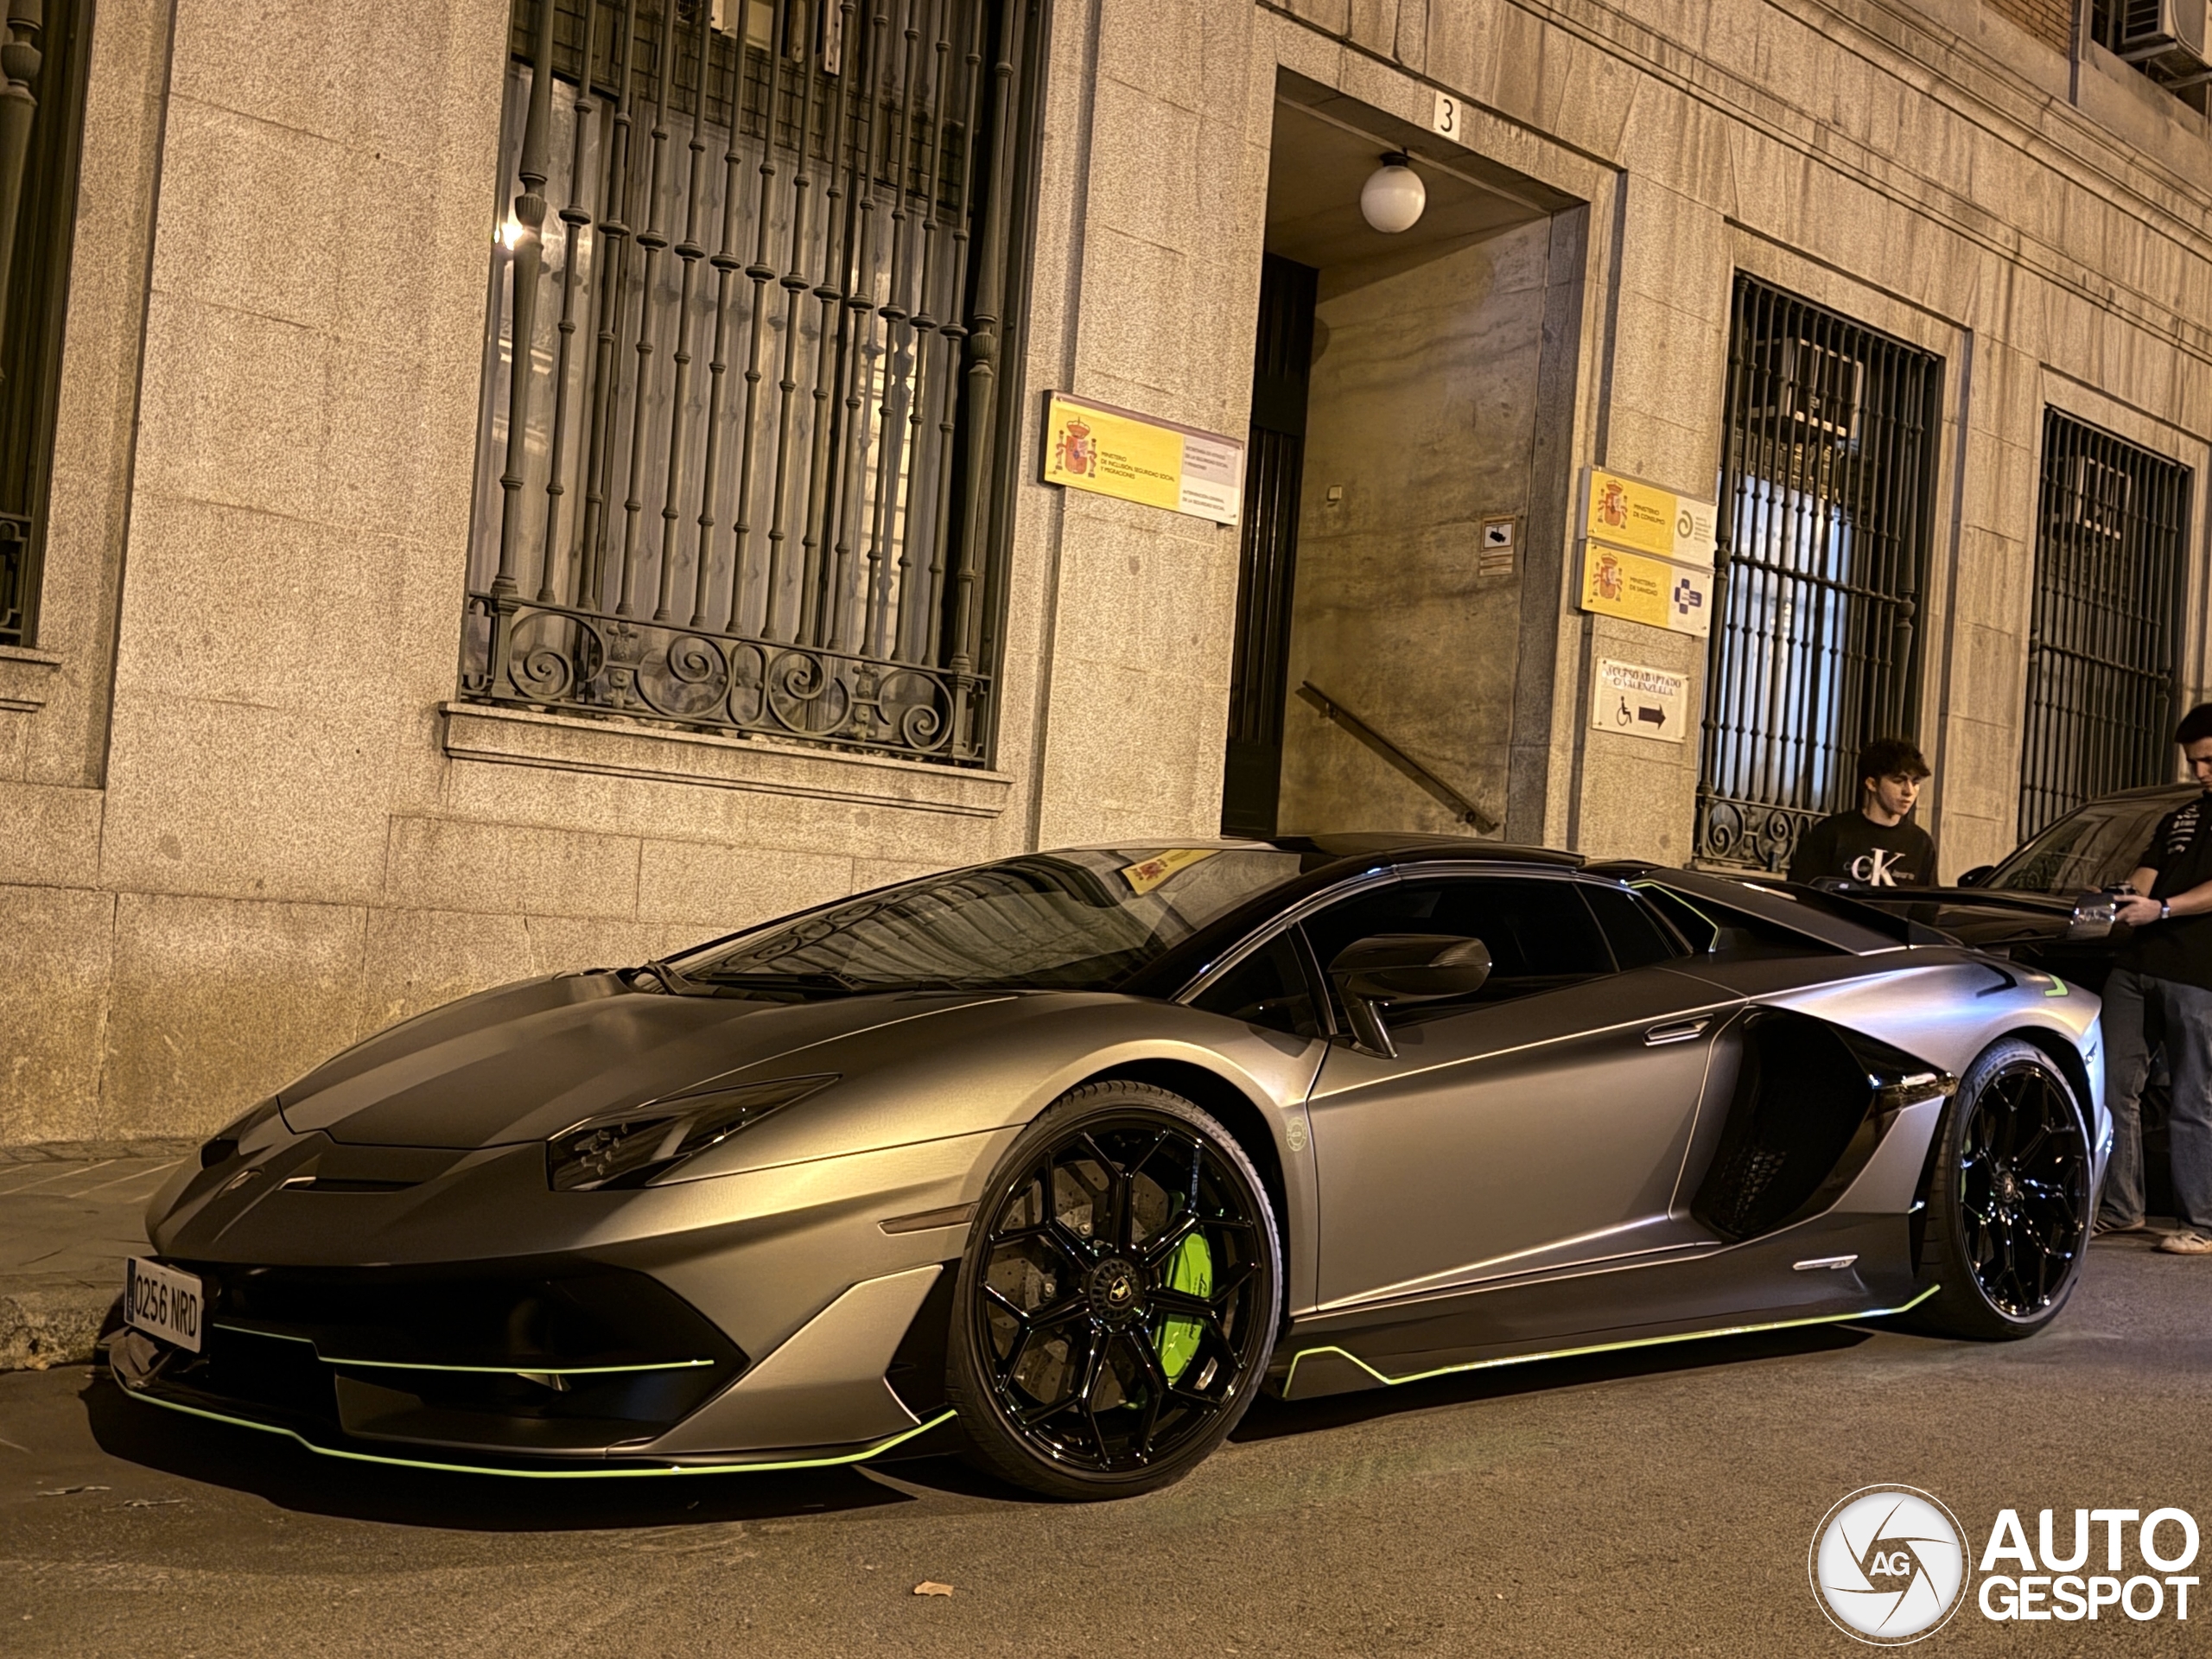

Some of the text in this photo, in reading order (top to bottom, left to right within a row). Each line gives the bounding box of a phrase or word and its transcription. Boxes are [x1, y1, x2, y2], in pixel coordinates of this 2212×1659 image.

[1440, 99, 1453, 132] 3
[135, 1274, 197, 1338] 0256 NRD
